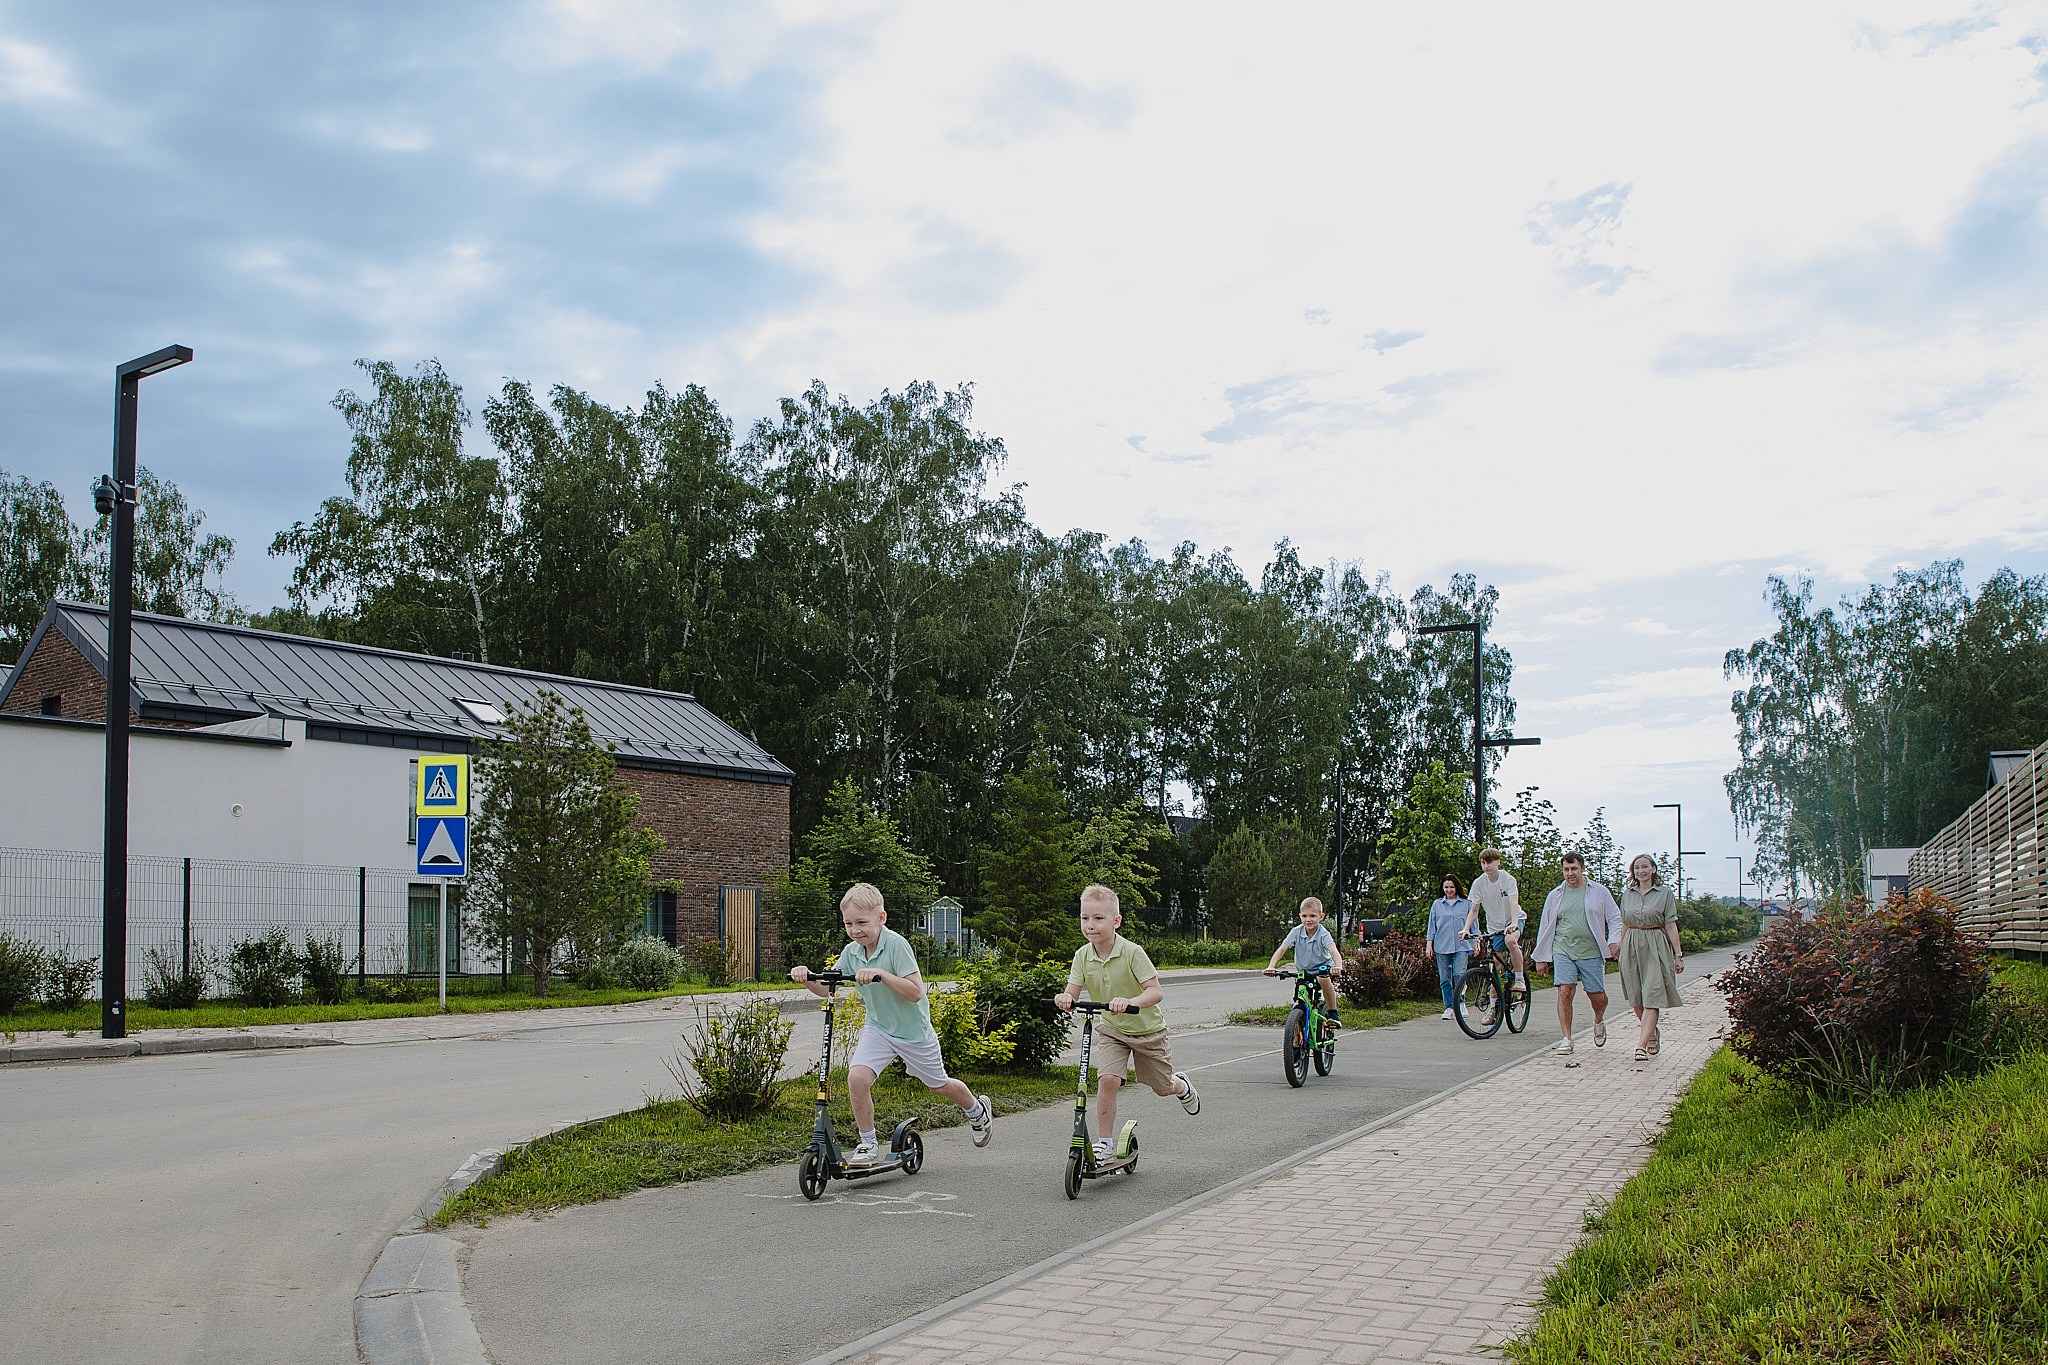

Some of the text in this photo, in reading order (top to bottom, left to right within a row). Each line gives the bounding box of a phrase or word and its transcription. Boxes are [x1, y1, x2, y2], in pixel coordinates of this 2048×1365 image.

[822, 1024, 830, 1057] ACTION
[1079, 1034, 1091, 1082] RUSH ACTION
